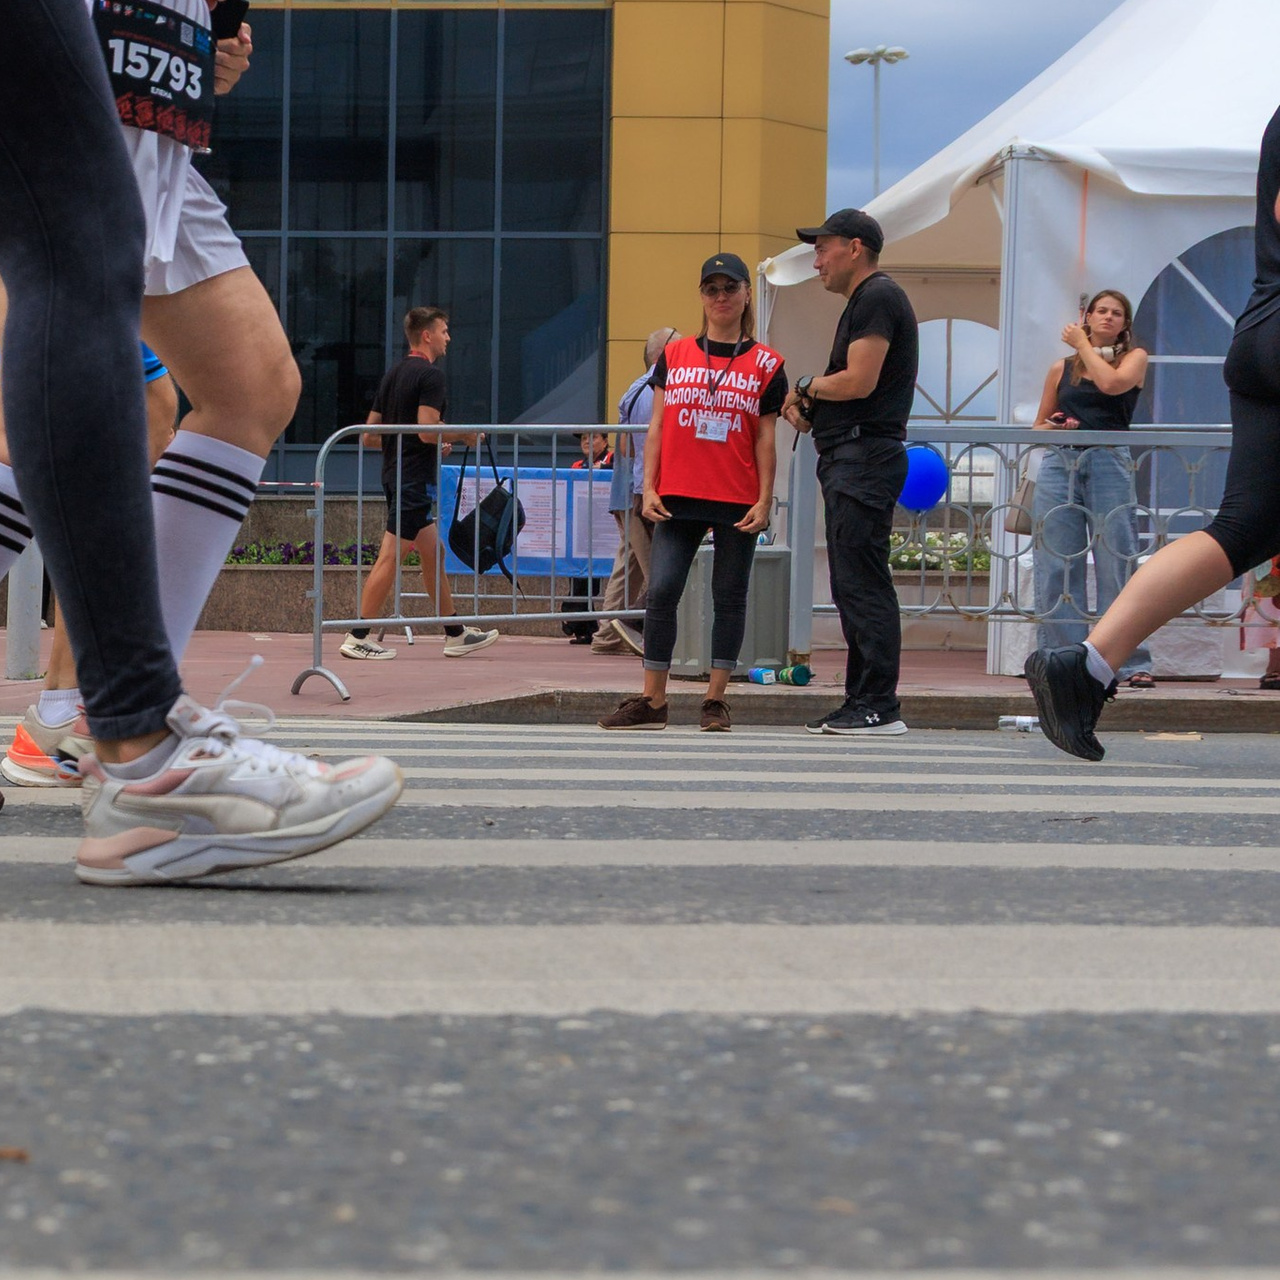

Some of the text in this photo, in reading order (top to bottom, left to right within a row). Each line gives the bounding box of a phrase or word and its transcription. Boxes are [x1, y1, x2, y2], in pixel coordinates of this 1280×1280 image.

[108, 38, 203, 100] 15793
[755, 348, 778, 374] 114
[665, 366, 762, 393] КОНТРОЛЬН
[663, 386, 761, 417] РАСПОРЯДИТЕЛЬНА
